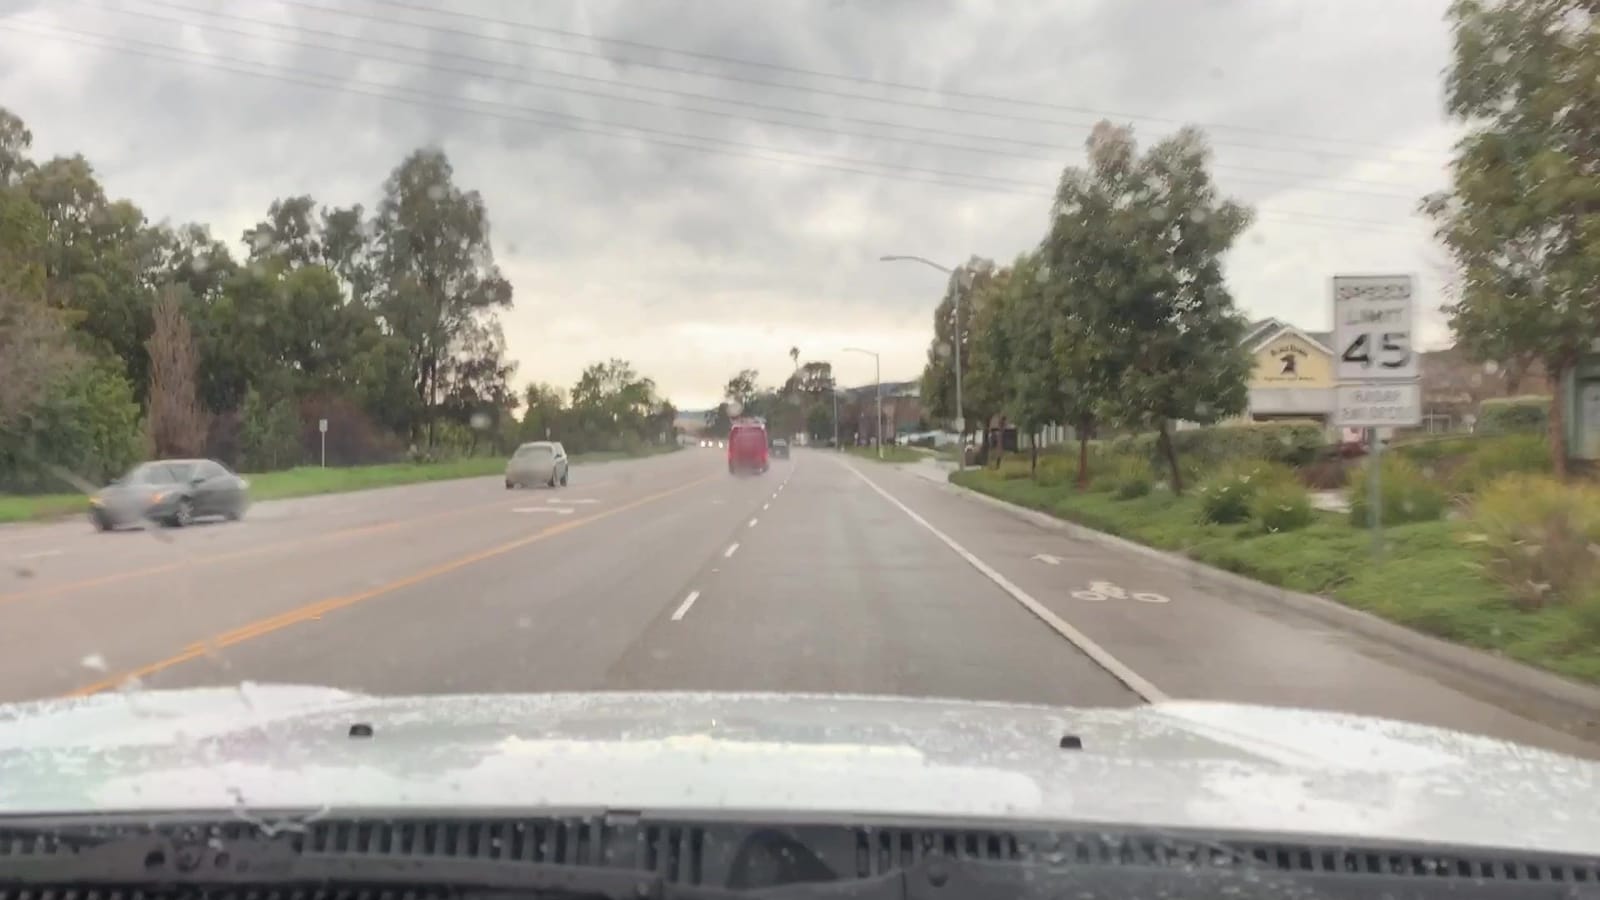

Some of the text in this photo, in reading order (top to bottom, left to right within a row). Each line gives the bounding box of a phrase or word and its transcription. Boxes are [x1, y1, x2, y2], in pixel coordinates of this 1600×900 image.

[1338, 285, 1411, 301] SPEED
[1344, 307, 1404, 325] LIMIT
[1342, 333, 1412, 369] 45
